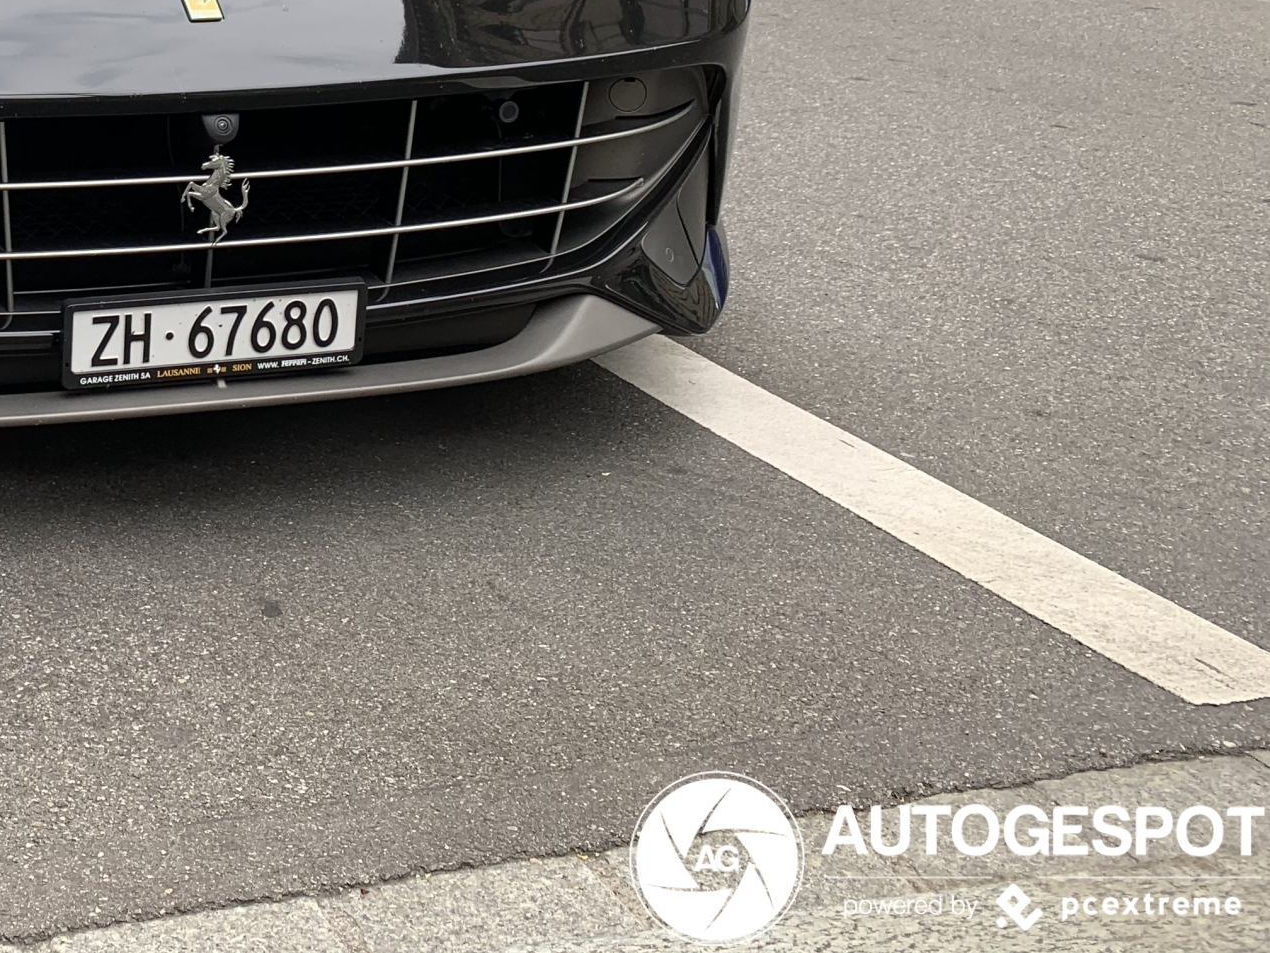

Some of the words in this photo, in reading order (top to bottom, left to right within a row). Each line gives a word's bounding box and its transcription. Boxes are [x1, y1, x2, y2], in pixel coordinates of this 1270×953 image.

[91, 313, 152, 367] ZH
[188, 298, 338, 359] 67680
[80, 376, 113, 385] GARAGE
[114, 373, 139, 382] ZENITH
[140, 372, 151, 380] SA
[157, 367, 201, 378] LAUSANNE
[232, 363, 252, 372] SION
